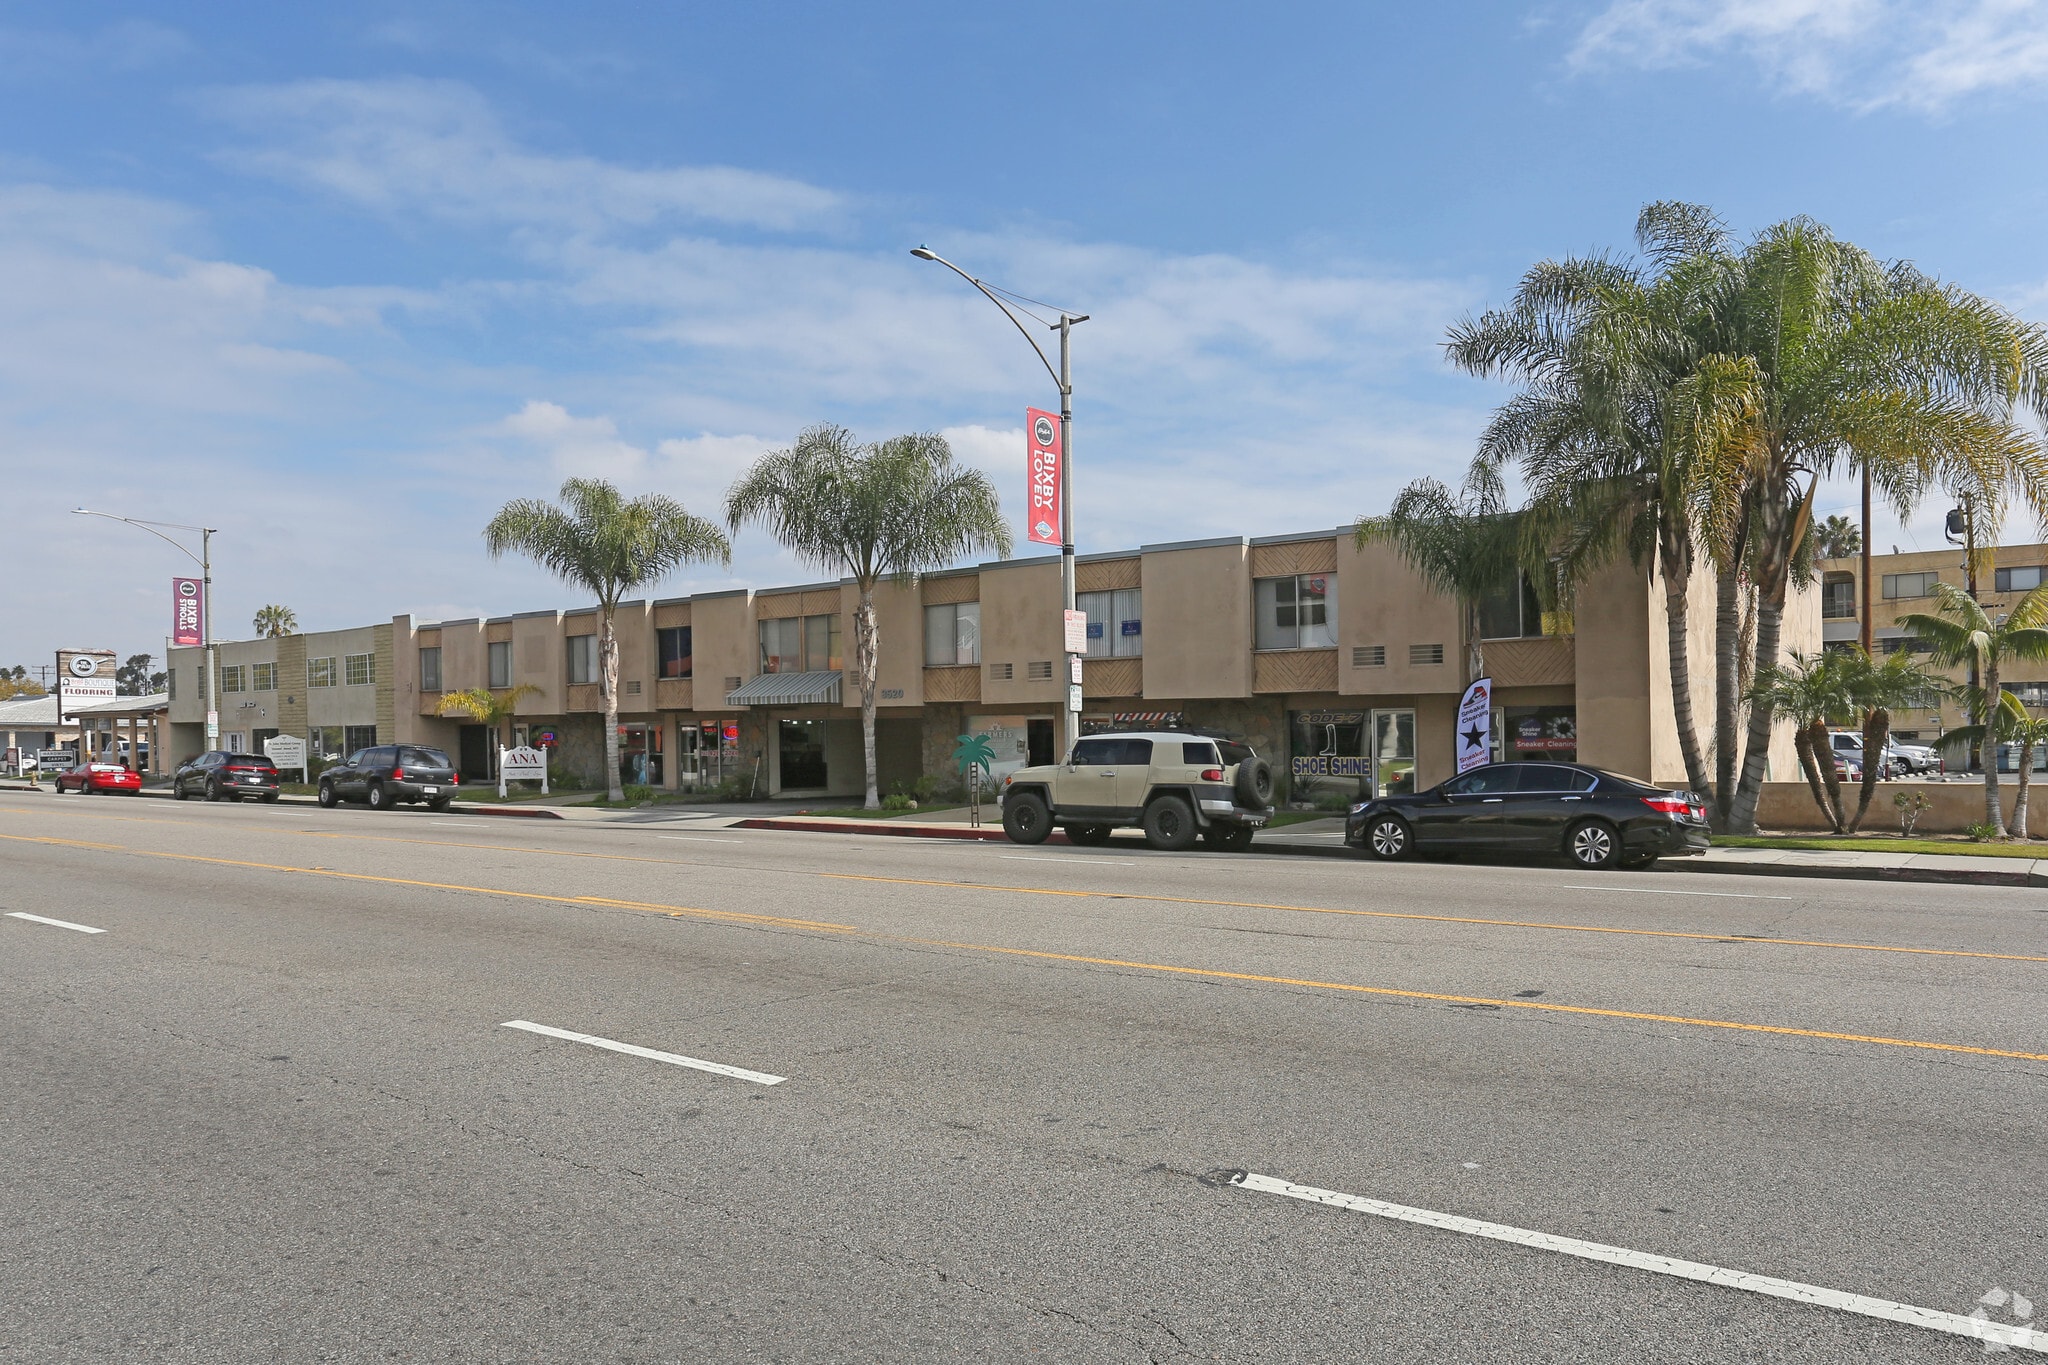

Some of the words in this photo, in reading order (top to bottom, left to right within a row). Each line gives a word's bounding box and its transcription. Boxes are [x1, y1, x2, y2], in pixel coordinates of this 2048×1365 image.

[1033, 449, 1043, 508] LOVED
[1043, 450, 1056, 511] BIXBY
[179, 598, 187, 630] STROLLS
[187, 599, 197, 631] BIXBY
[84, 679, 115, 687] BOUTIQUE
[65, 688, 113, 696] FLOORING
[1461, 703, 1486, 718] Sneaker
[1461, 709, 1488, 724] Cleaning
[1547, 740, 1577, 748] Cleaning
[509, 754, 538, 764] ANA
[1459, 749, 1485, 763] Sneaker
[1460, 755, 1488, 770] Cleaning
[1292, 756, 1328, 776] SHOE
[1330, 756, 1371, 776] SHINE
